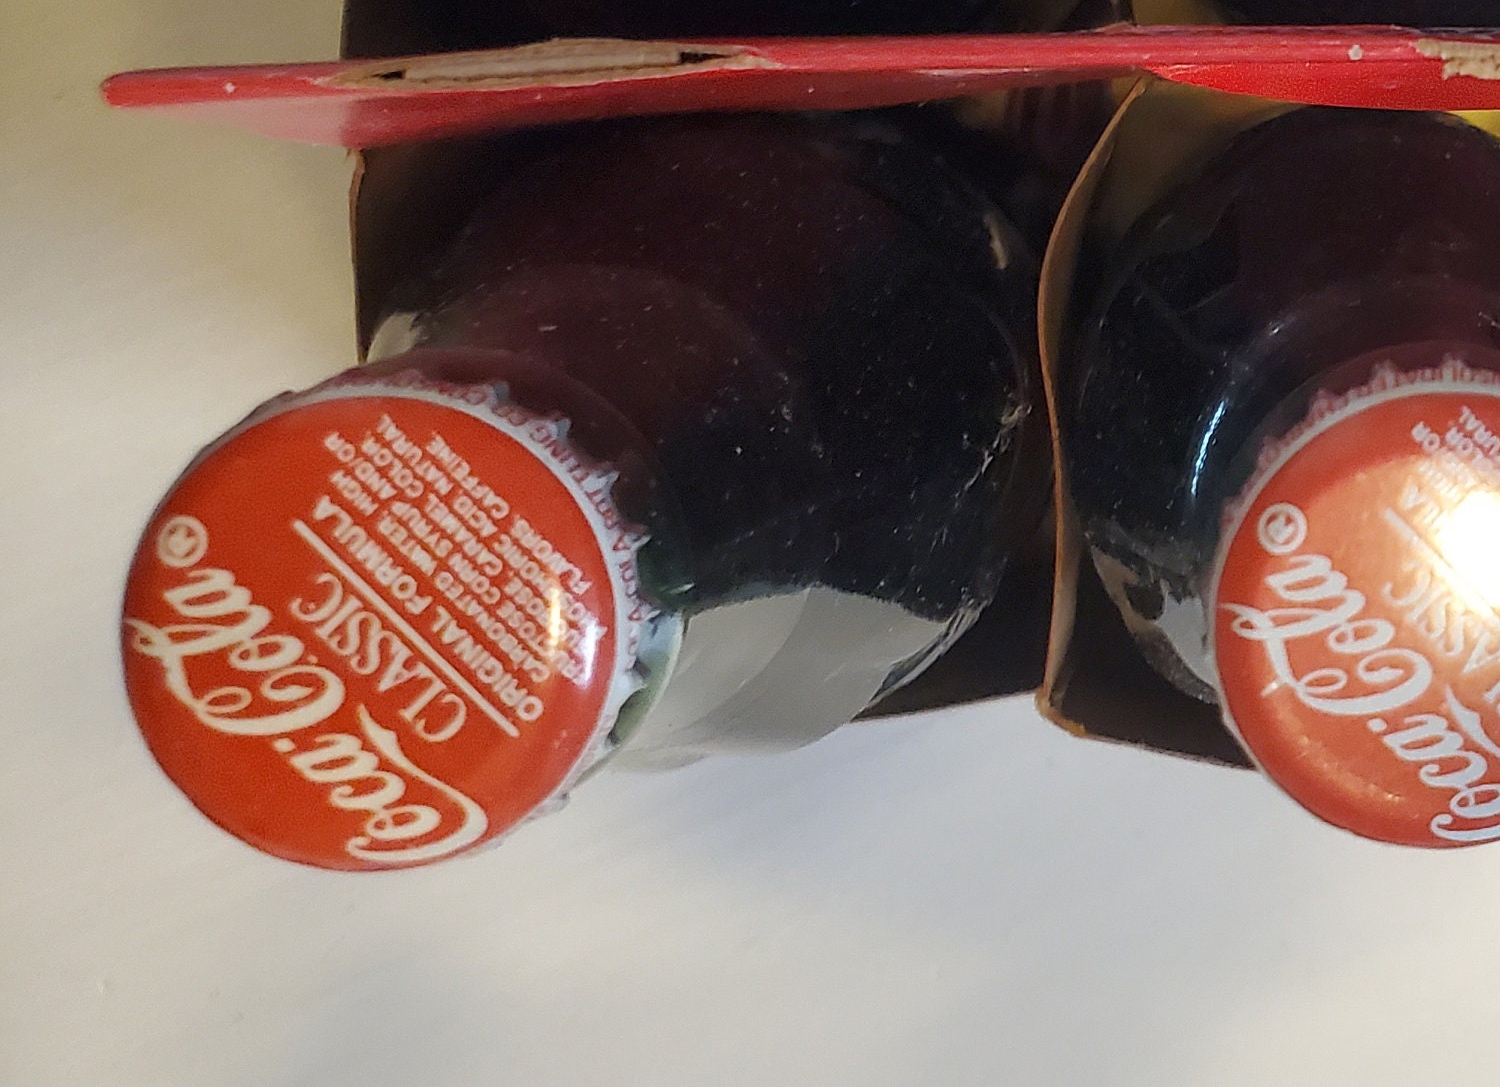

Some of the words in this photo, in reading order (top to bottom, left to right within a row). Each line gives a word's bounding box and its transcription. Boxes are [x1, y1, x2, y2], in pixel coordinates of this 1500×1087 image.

[321, 428, 399, 504] AND/OR
[328, 466, 379, 517] HIGH
[370, 412, 457, 497] NATURAL
[306, 492, 434, 618] FORMULA
[388, 494, 454, 560] SYRUP
[417, 492, 505, 579] CARAMEL
[430, 567, 552, 686] CARBONATED
[444, 549, 504, 607] CORN
[490, 529, 608, 645] HOSHORIC
[287, 566, 476, 753] CLASSIC
[421, 601, 547, 726] ORIGINAL
[126, 563, 486, 864] Coca-Cola
